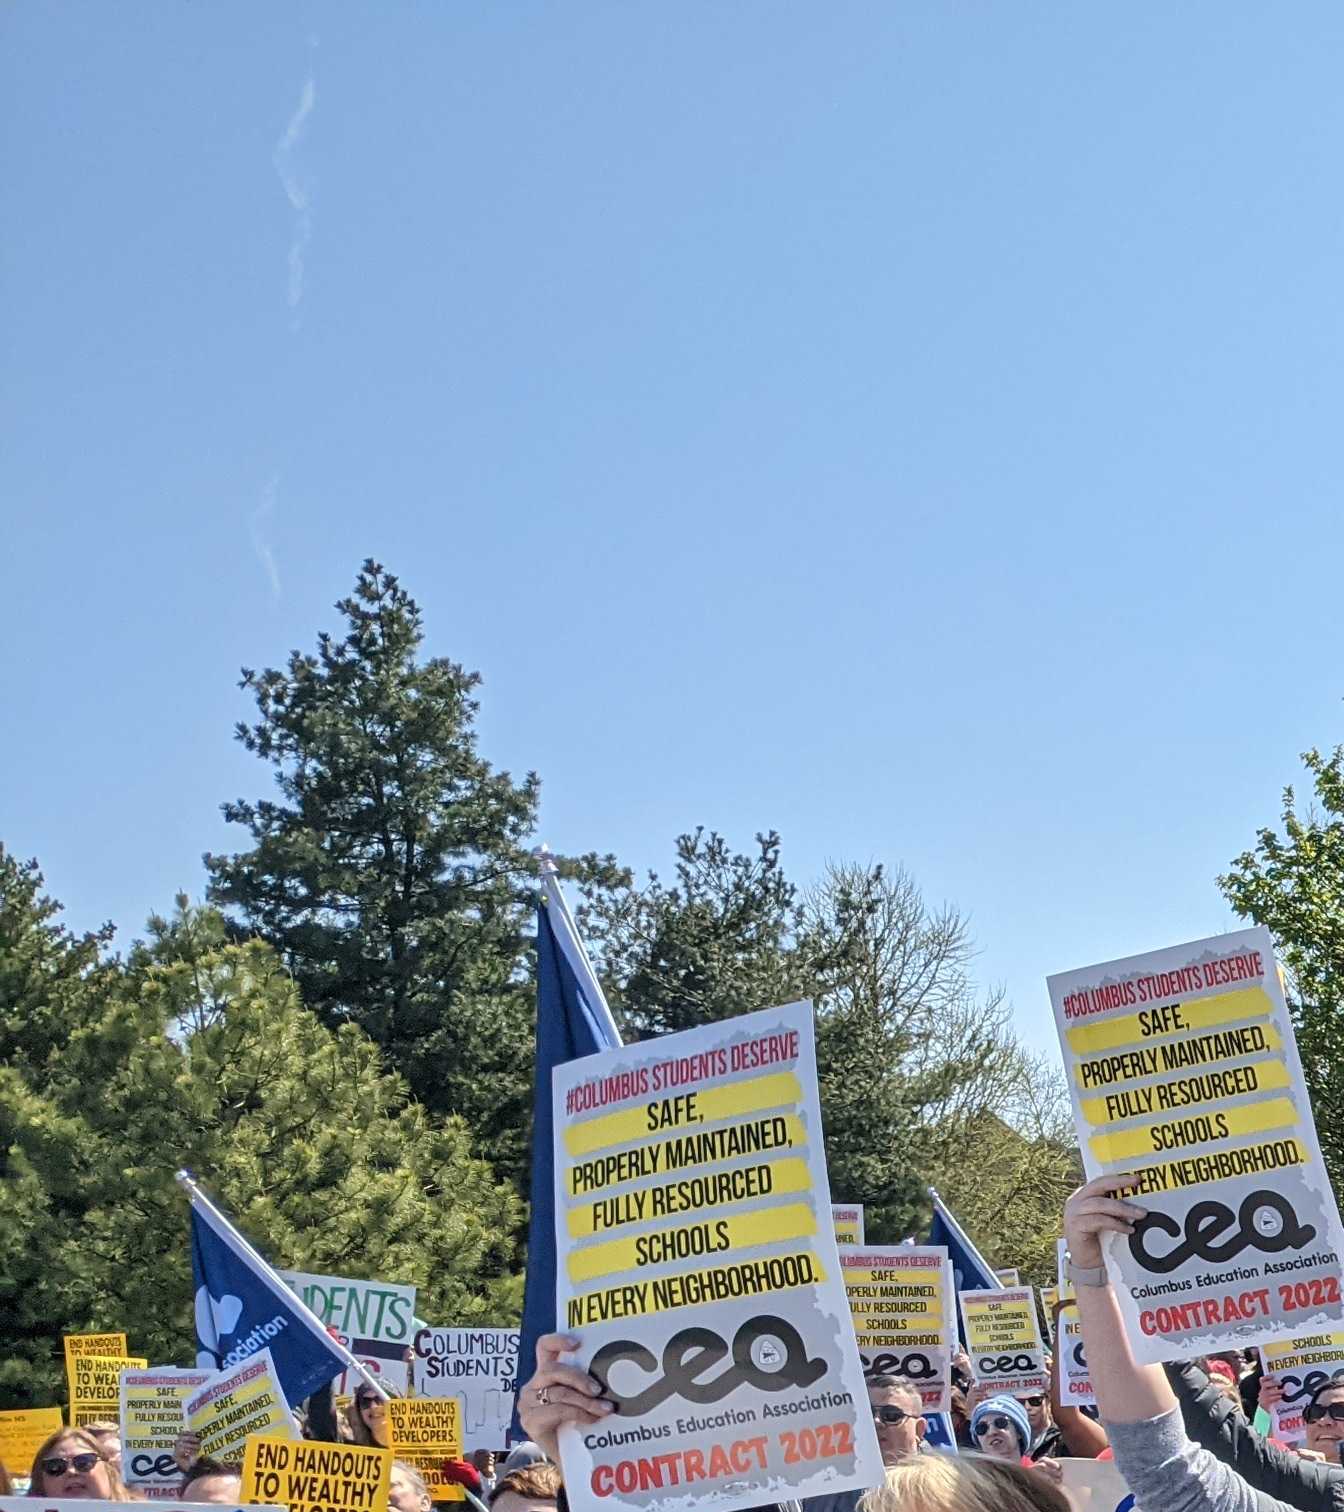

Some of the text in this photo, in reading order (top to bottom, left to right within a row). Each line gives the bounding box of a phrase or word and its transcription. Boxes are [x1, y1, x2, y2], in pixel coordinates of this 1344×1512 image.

[1063, 952, 1265, 1019] #COLUMBUS STUDENTS DESERVE
[1138, 1006, 1191, 1037] SAFE,
[566, 1031, 799, 1115] #COLUMBUS STUDENTS DESERVE
[1081, 1025, 1271, 1089] PROPERLY MAINTAINED,
[647, 1091, 705, 1131] SAFE,
[1105, 1067, 1258, 1121] FULLY RESOURCED
[1150, 1114, 1230, 1152] SCHOOLS
[572, 1118, 793, 1194] PROPERLY MAINTAINED,
[1170, 1140, 1305, 1187] NEIGHBORHOOD.
[592, 1165, 773, 1231] FULLY RESOURCED
[635, 1222, 730, 1265] SCHOOLS
[1128, 1189, 1316, 1274] cea
[586, 1254, 819, 1323] EVERY NEIGHBORHOOD.
[1130, 1251, 1338, 1301] Columbus Education Association
[866, 1319, 907, 1330] SCHOOLS
[872, 1302, 927, 1312] RESOURCED
[1139, 1276, 1341, 1337] CONTRACT 2022
[414, 1329, 520, 1358] COLUMBUS
[426, 1356, 515, 1378] STUDENTS
[390, 1402, 455, 1415] END HANDOUTS
[392, 1417, 455, 1429] TO WEALTHY
[584, 1391, 853, 1450] Columbus Education Association
[393, 1430, 456, 1442] DEVELOPERS.
[256, 1443, 382, 1481] END HANDOUTS
[590, 1421, 854, 1499] CONTRACT 2022
[254, 1472, 378, 1508] TO WEALTHY
